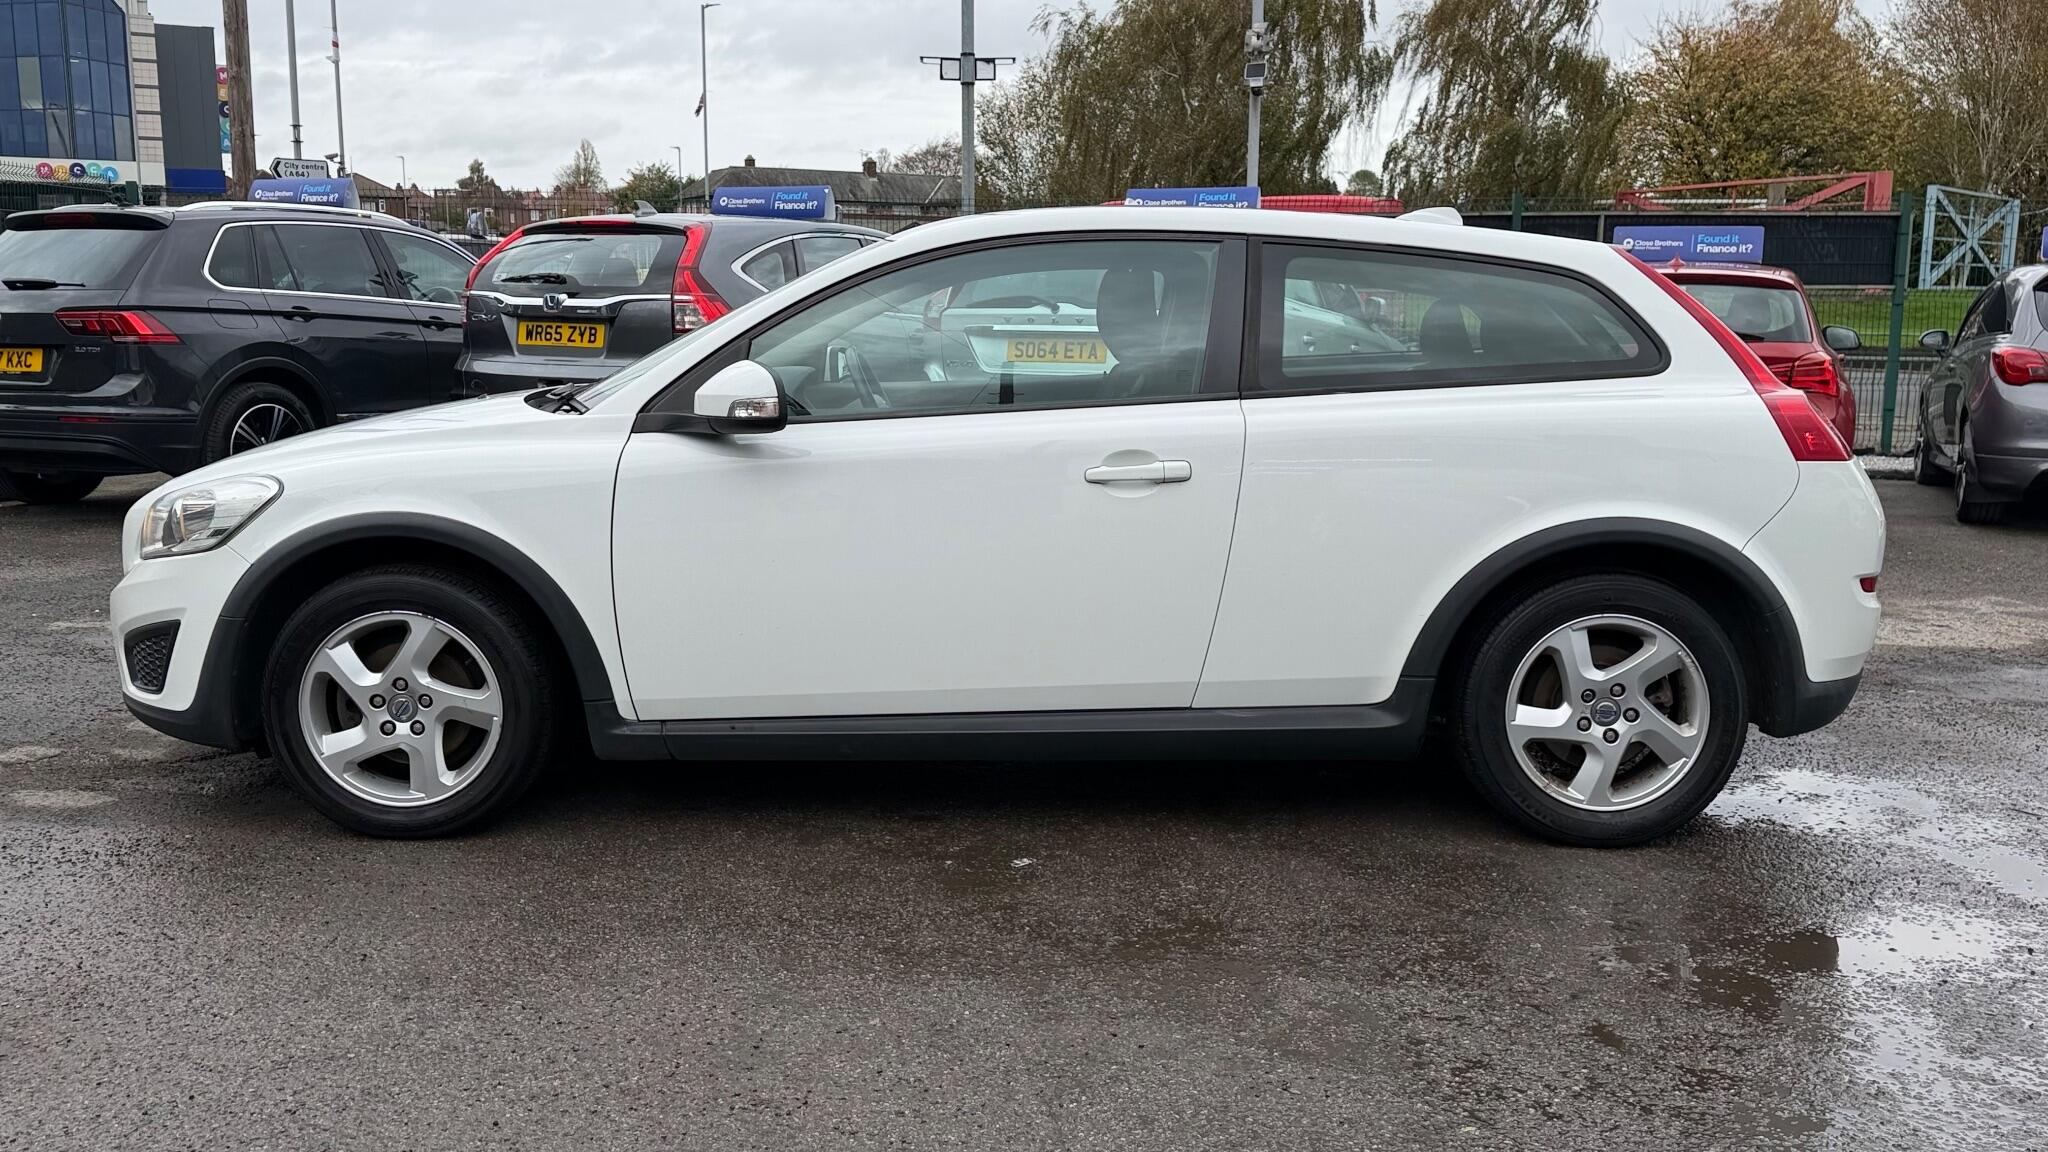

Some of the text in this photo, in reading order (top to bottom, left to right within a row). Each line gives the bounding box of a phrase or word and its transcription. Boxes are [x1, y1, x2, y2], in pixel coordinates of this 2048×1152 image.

[284, 162, 325, 171] City centre
[284, 169, 310, 178] (A64)
[303, 184, 331, 193] Found it
[300, 193, 338, 202] Finance it?
[776, 191, 809, 200] Found it
[1199, 192, 1236, 201] Found it
[774, 200, 818, 210] Finance it?
[1697, 233, 1740, 243] Found it
[1634, 239, 1684, 247] Close Brothers
[1696, 243, 1753, 254] Finance it?
[525, 323, 598, 344] WR65 ZYB
[1014, 341, 1098, 359] SO64 ETA
[6, 351, 33, 368] KXC
